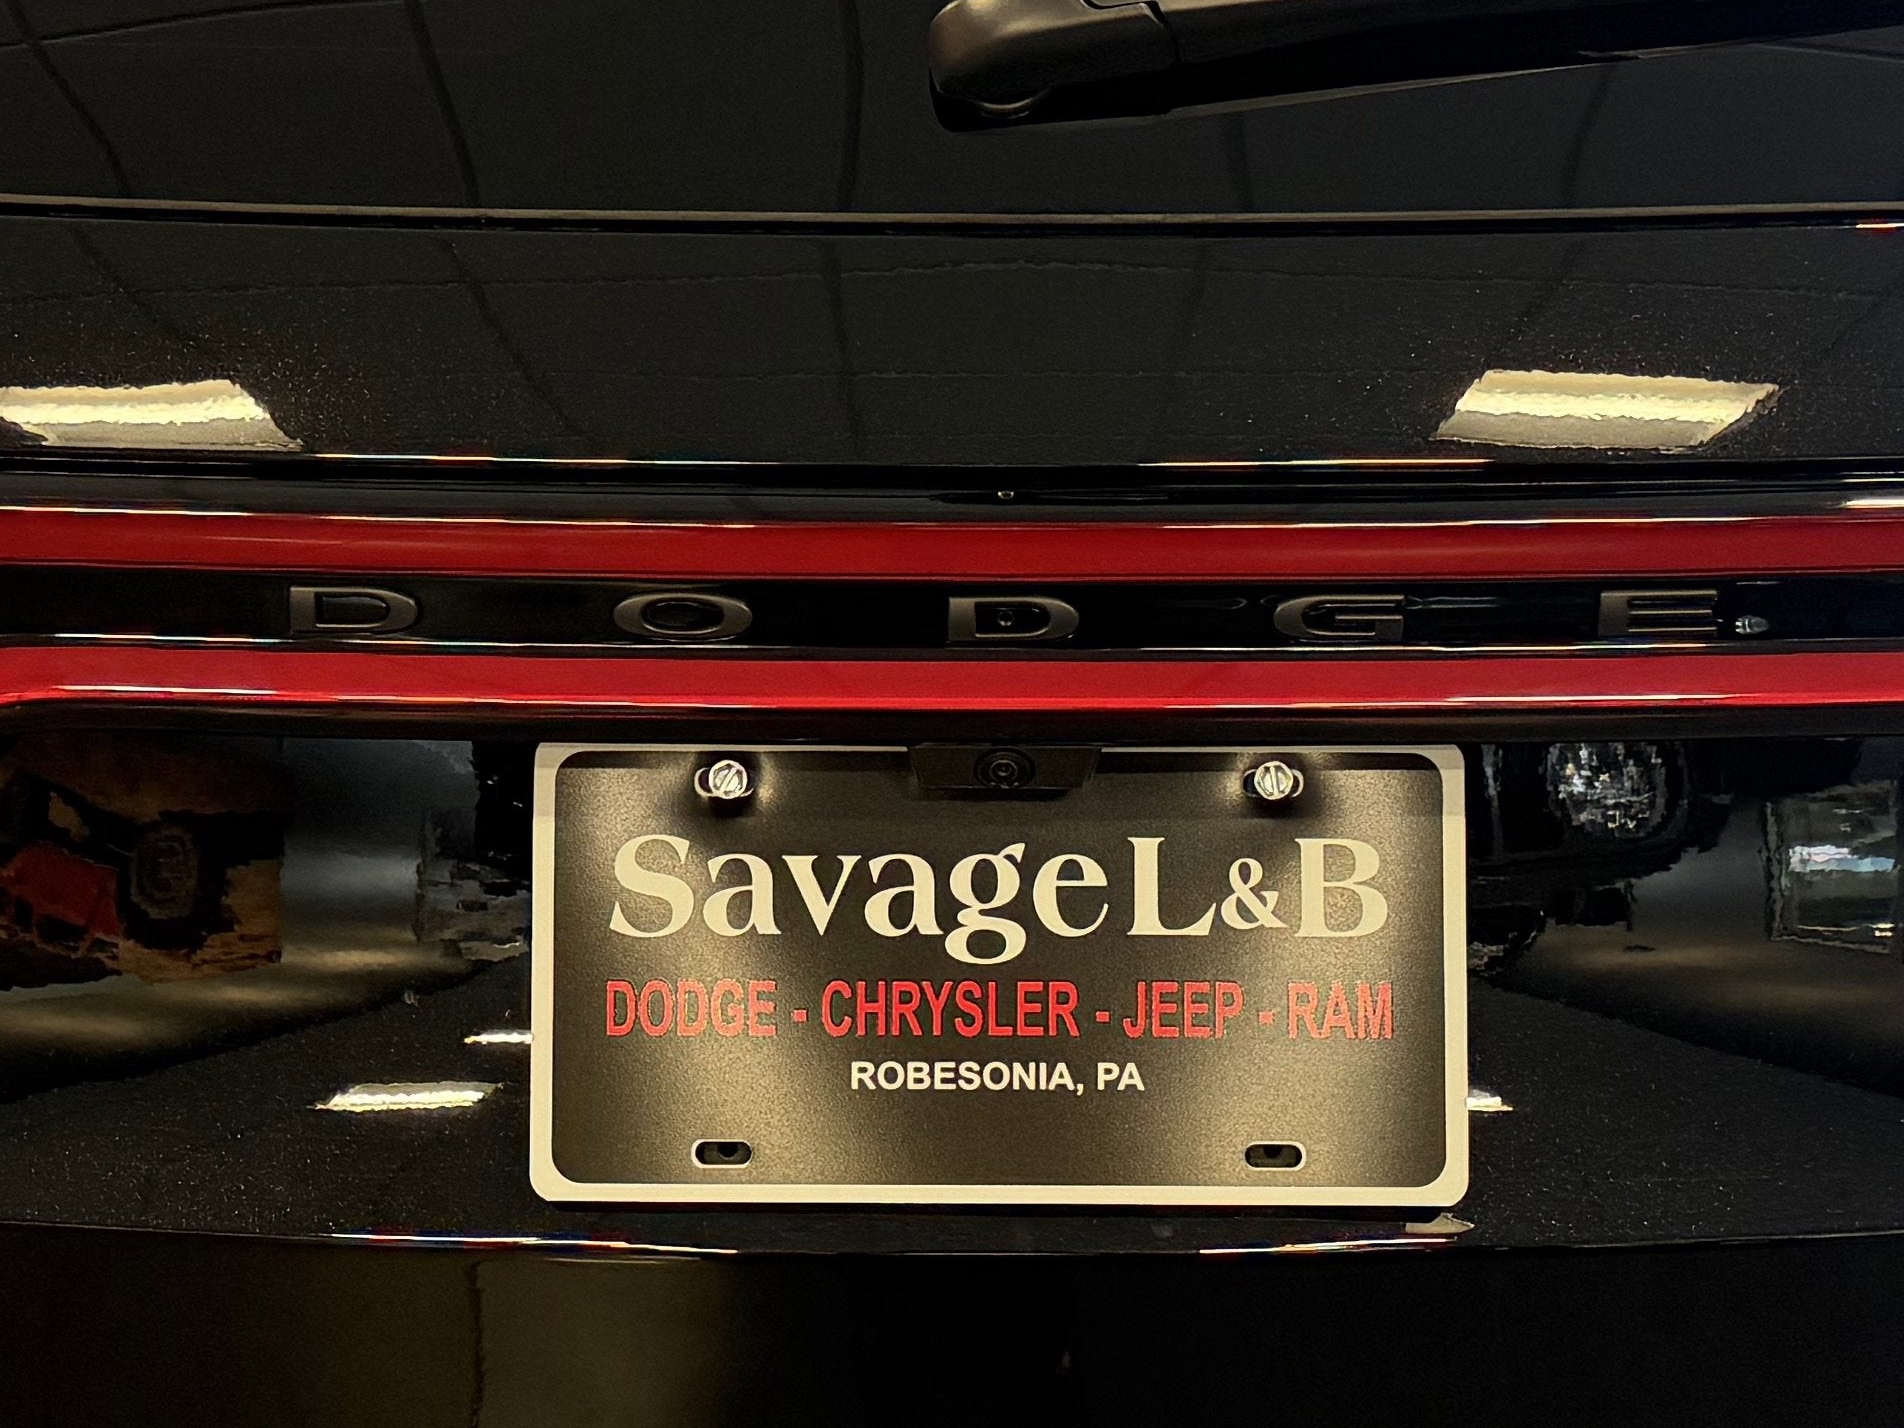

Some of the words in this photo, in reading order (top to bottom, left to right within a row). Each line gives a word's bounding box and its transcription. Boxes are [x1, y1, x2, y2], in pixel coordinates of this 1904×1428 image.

[289, 584, 1718, 643] DODGE
[605, 979, 778, 1038] DODGE
[821, 980, 1081, 1039] CHRYSLER
[1122, 980, 1245, 1039] JEEP
[1287, 980, 1394, 1040] RAM
[850, 1060, 1084, 1096] ROBESONIA,
[1097, 1062, 1146, 1091] PA
